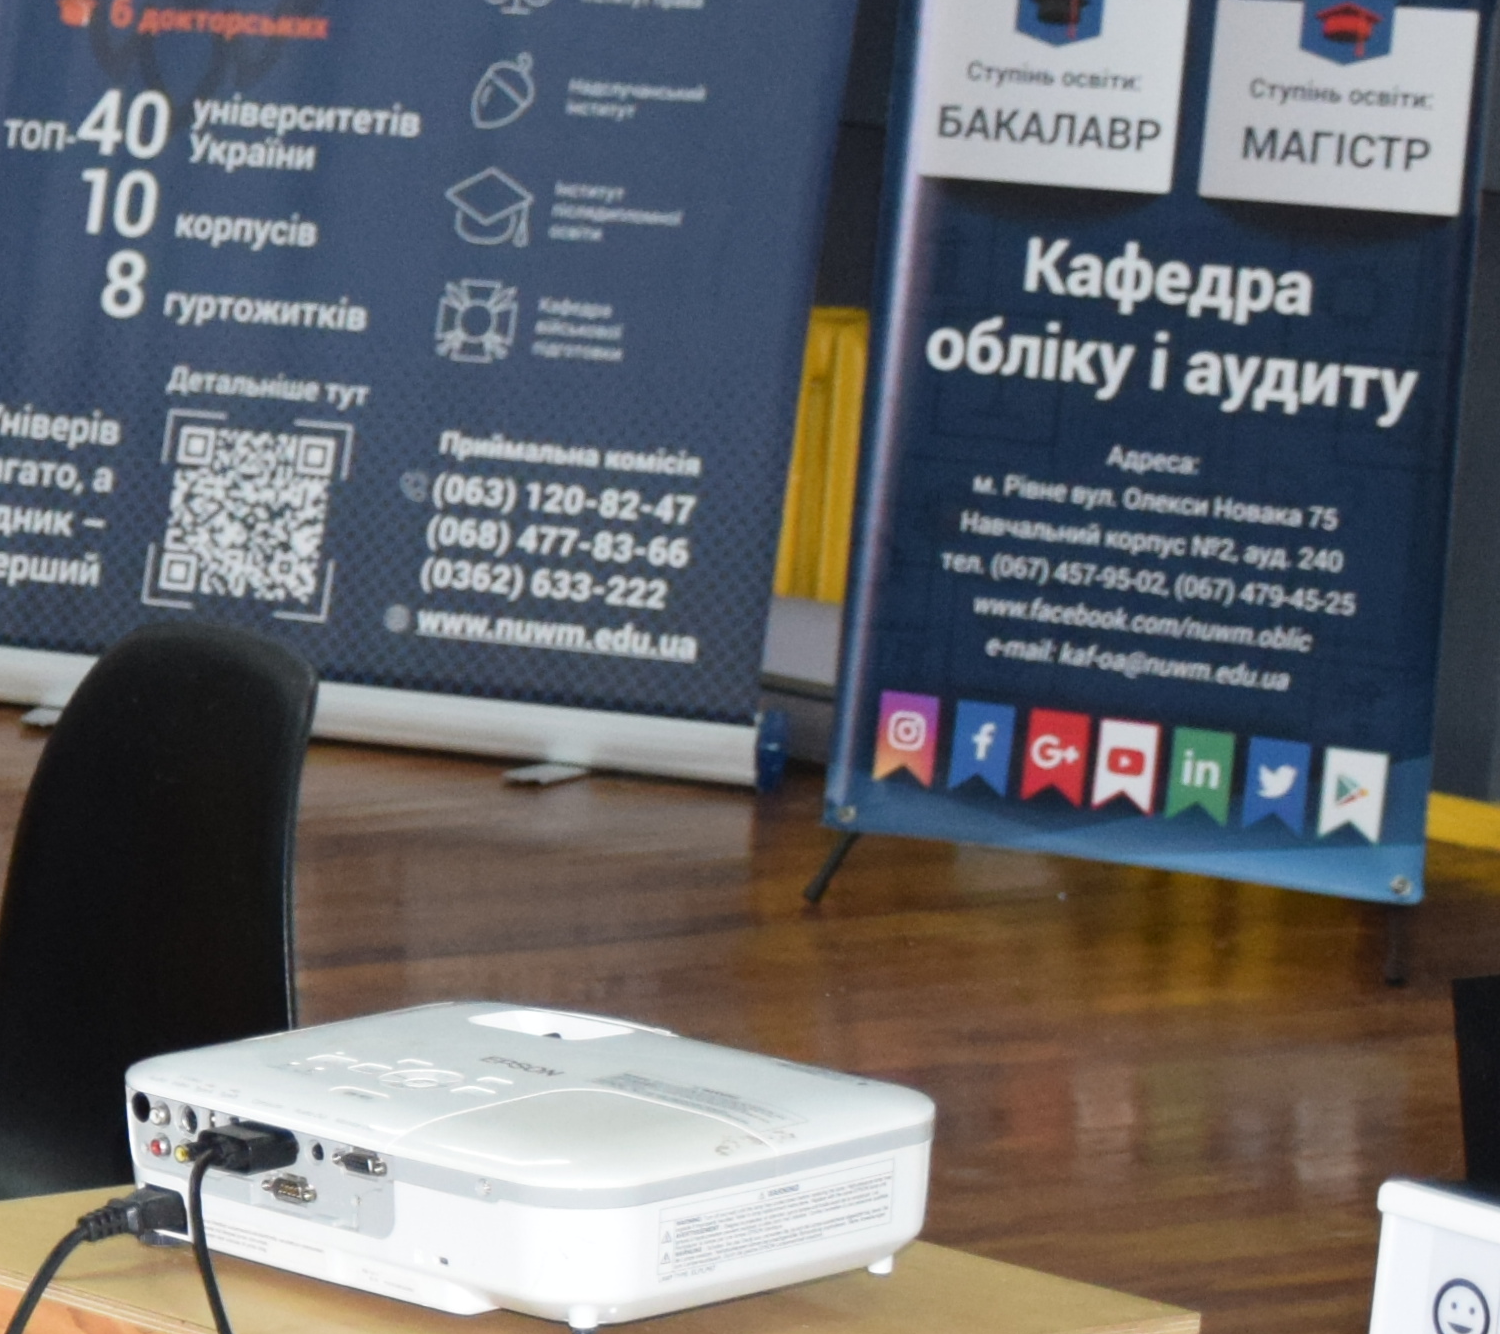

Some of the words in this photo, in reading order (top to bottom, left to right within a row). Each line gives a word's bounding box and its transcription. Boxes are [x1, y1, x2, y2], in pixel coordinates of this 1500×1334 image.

[965, 58, 1056, 93] Ступінь
[1061, 67, 1143, 94] освіти:
[1248, 75, 1344, 111] Ступінь
[1348, 85, 1437, 114] освіти:
[189, 93, 422, 139] університетів
[936, 103, 1163, 154] БАКАЛАВР
[187, 131, 317, 173] України
[1240, 124, 1433, 173] МАГІСТР
[80, 168, 160, 239] 10
[173, 211, 319, 251] корпусів
[100, 249, 148, 319] 8
[1022, 233, 1315, 326] Кафедра
[162, 289, 370, 334] гуртожитків
[164, 364, 321, 403] Детальніше
[324, 383, 371, 412] тут
[925, 314, 1138, 402] обліку
[1148, 328, 1171, 393] і
[1182, 348, 1421, 429] аудиту
[92, 470, 115, 495] а
[1105, 443, 1200, 477] Адреса:
[432, 471, 518, 515] (063)
[525, 481, 699, 527] 120-82-47
[1002, 471, 1068, 506] Рівне
[1308, 505, 1340, 533] 75
[426, 514, 512, 558] (068)
[516, 524, 690, 569] 477-83-66
[1296, 545, 1346, 575] 240
[419, 556, 525, 602] (0362)
[529, 569, 670, 611] 633-222
[989, 551, 1051, 586] (067)
[1173, 572, 1236, 608] (067)
[416, 608, 700, 664] www.nuwm.edu.ua
